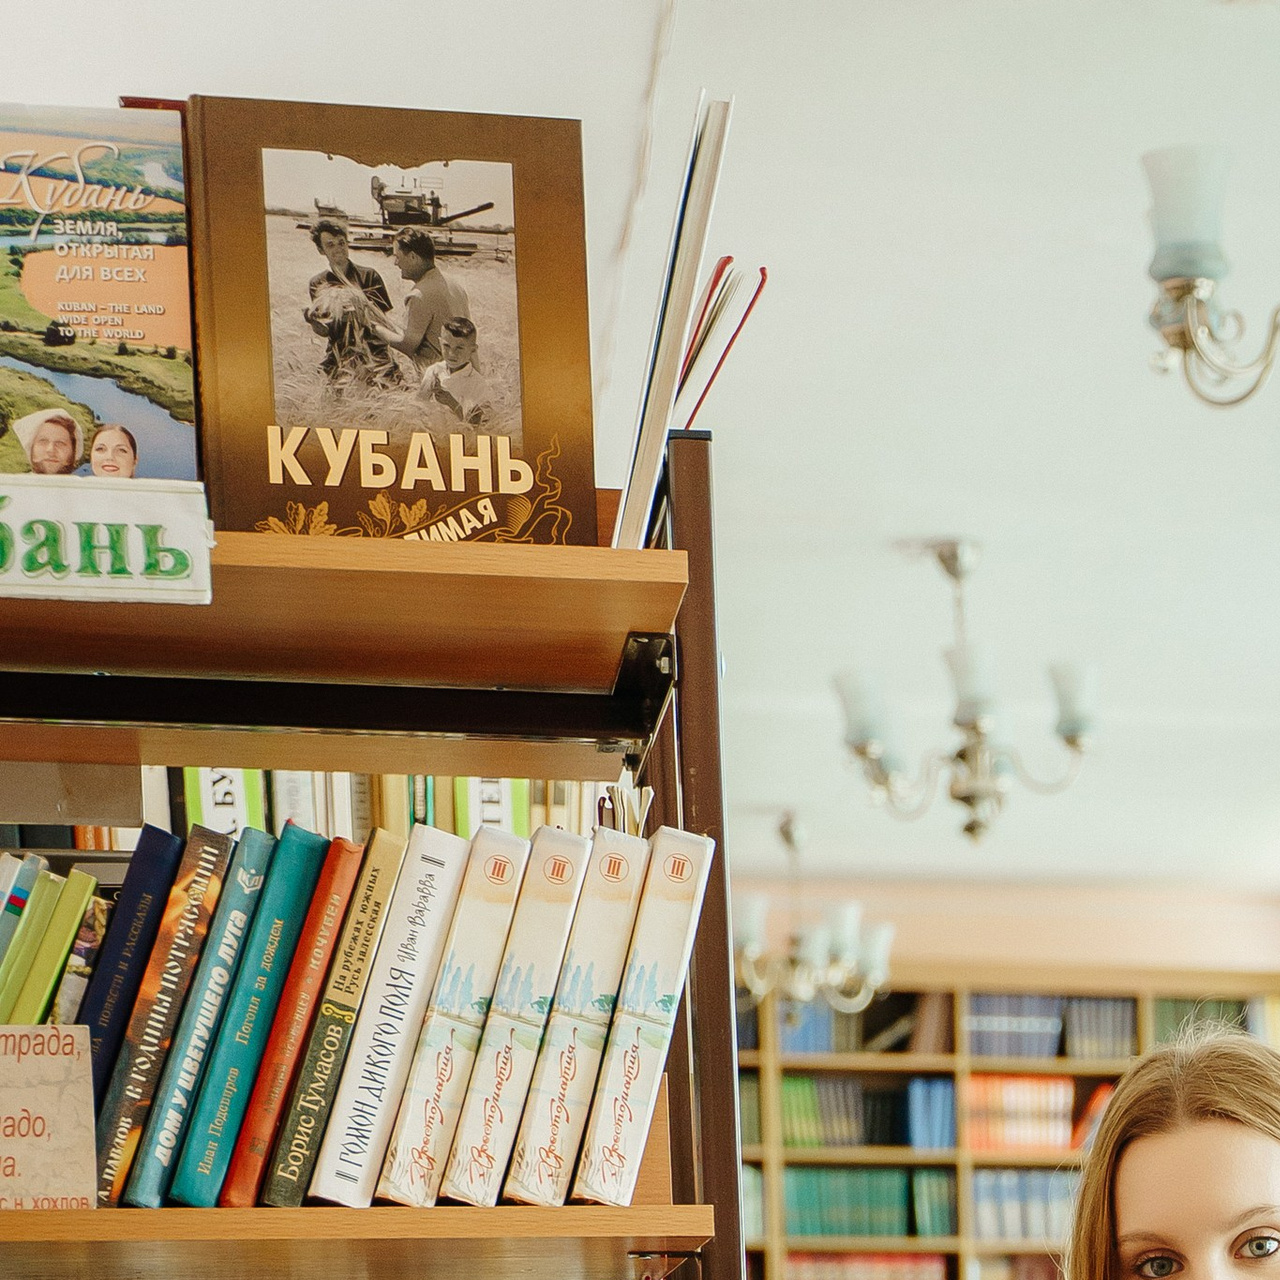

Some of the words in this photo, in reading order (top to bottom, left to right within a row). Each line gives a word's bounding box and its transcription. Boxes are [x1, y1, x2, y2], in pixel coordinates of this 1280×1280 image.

[0, 143, 155, 242] Кубань
[53, 219, 123, 239] ЗЕМЛЯ,
[54, 243, 155, 260] ОТКРЫТАЯ
[56, 265, 94, 282] ДЛЯ
[101, 267, 147, 282] ВСЕХ
[57, 302, 96, 312] KUBAN
[109, 303, 130, 313] THE
[135, 304, 165, 314] LAND
[59, 315, 88, 325] WIDE
[92, 316, 123, 326] OPEN
[78, 328, 99, 337] THE
[103, 328, 144, 339] WORLD
[266, 424, 535, 495] КУБАНЬ
[360, 866, 382, 915] южных
[122, 893, 153, 958] РАССКАЗЫ
[338, 920, 364, 976] рубежах
[345, 961, 364, 995] Русь
[357, 900, 382, 960] залесская
[398, 929, 425, 963] Иван
[332, 975, 345, 992] На
[379, 966, 416, 1030] ПОЛЯ
[155, 1110, 183, 1167] ДОМ
[181, 965, 231, 1095] ЦВЕТУЩЕГО
[217, 909, 248, 961] ЛУГА
[197, 1144, 218, 1176] Иван
[208, 1067, 240, 1137] Подсвиров
[236, 994, 261, 1046] Погоня
[261, 918, 285, 972] дождем
[359, 1022, 401, 1103] ДИКОГО
[277, 1116, 314, 1182] Борис
[298, 1023, 344, 1115] Тумасов
[338, 1100, 379, 1169] ГОМОН
